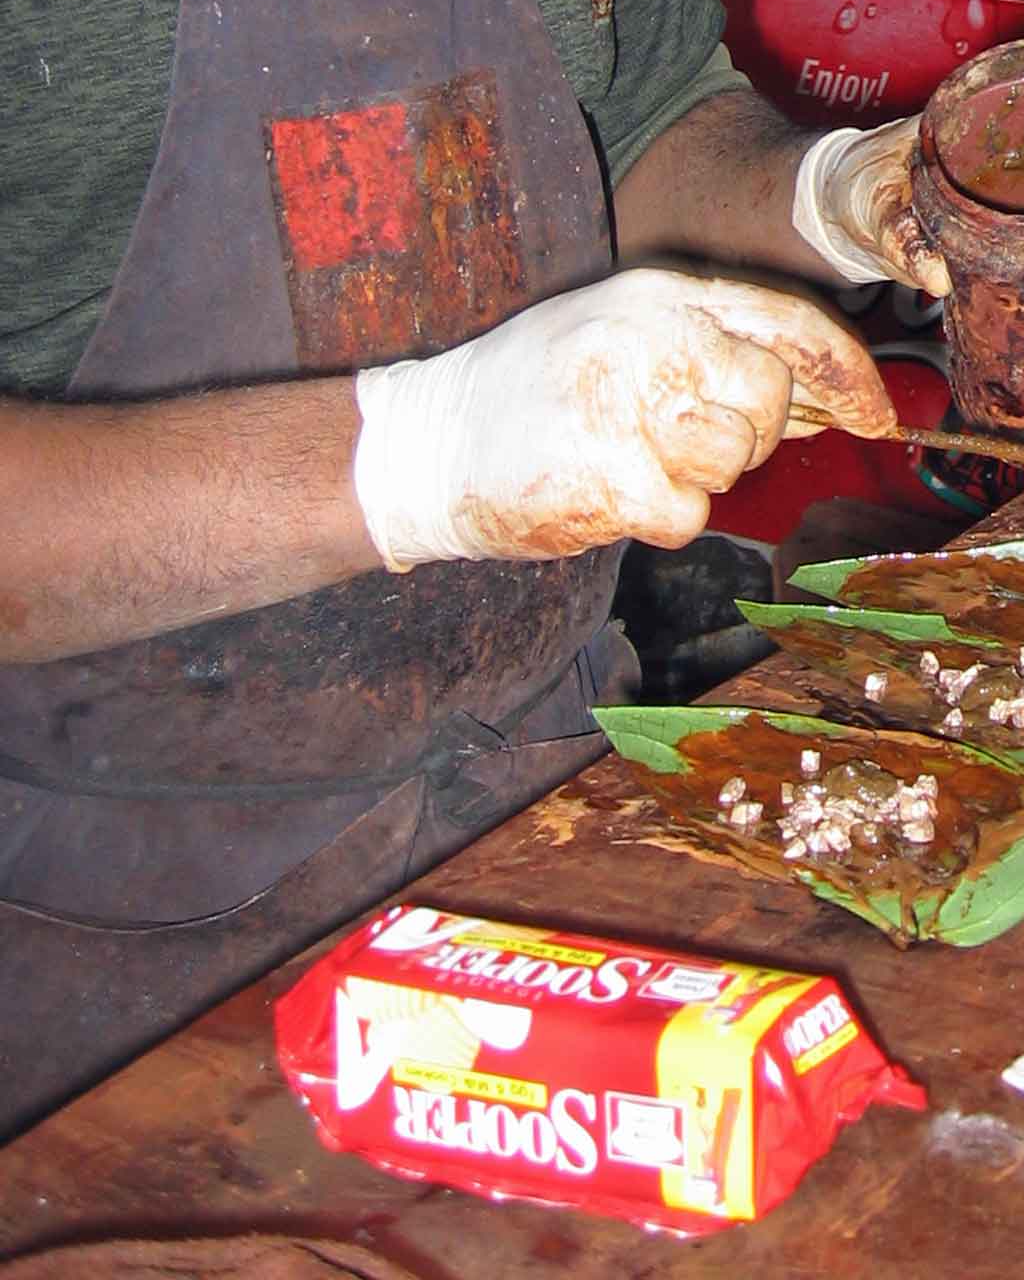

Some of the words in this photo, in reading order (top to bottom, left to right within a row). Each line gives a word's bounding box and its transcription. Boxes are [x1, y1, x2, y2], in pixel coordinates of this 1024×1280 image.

[795, 58, 890, 113] Enjoy!
[421, 944, 653, 1004] SOOPER
[393, 1086, 599, 1176] SOOPER
